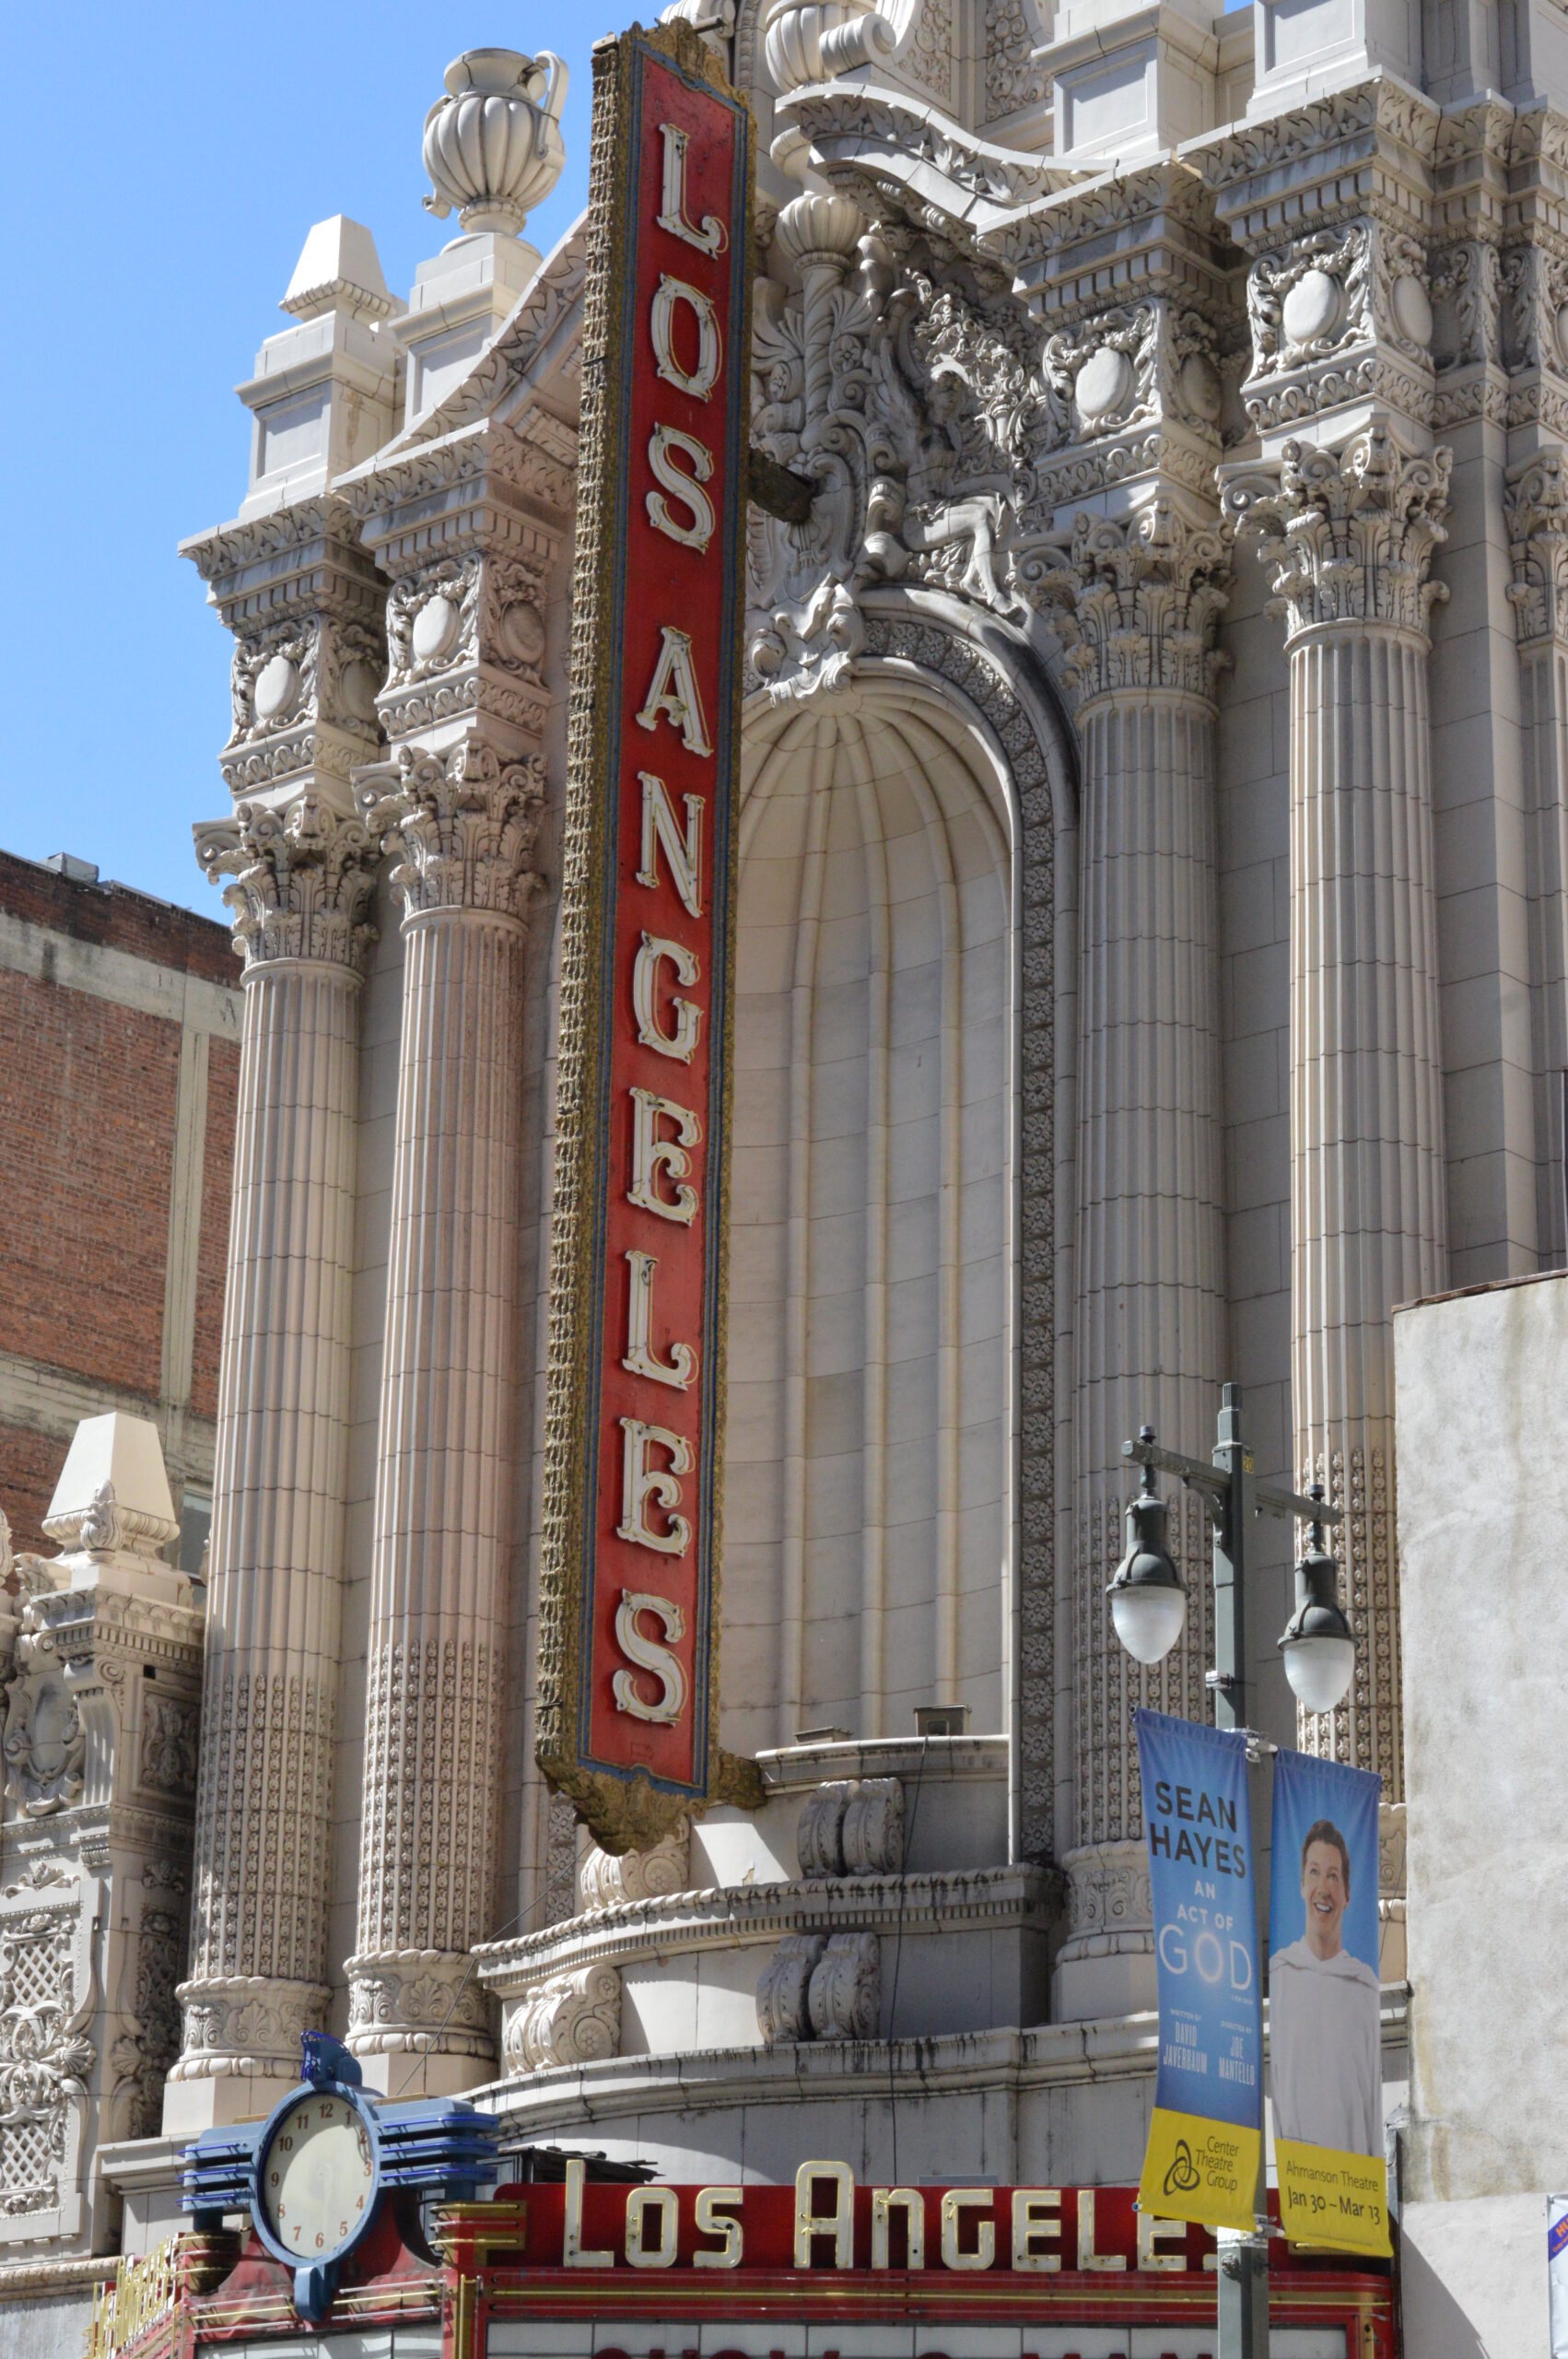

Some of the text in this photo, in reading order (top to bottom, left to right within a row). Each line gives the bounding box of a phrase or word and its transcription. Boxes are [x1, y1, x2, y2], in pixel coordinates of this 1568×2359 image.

[613, 123, 729, 1727] LOS ANGELES
[1155, 1781, 1236, 1833] SEAN
[1150, 1823, 1246, 1879] HAYES
[1194, 1880, 1216, 1900] AN
[1177, 1903, 1234, 1931] ACT OF
[1158, 1924, 1252, 1990] GOD
[1175, 2021, 1198, 2048] DAVID
[1163, 2044, 1207, 2074] JAVERBAUM
[1231, 2036, 1243, 2059] JOE
[1219, 2056, 1255, 2086] MANTELLO
[319, 2103, 333, 2118] 12
[345, 2110, 352, 2125] 1
[297, 2115, 309, 2130] 11
[277, 2136, 293, 2152] 10
[1207, 2136, 1239, 2156] Center
[364, 2162, 372, 2177] 3
[1195, 2149, 1234, 2172] Theatre
[271, 2172, 279, 2188] 9
[1206, 2170, 1238, 2195] Group
[1286, 2160, 1378, 2192] Ahmanson Theatre
[277, 2204, 286, 2219] 8
[356, 2195, 364, 2211] 4
[1288, 2185, 1307, 2210] Jan
[1310, 2194, 1326, 2213] 30
[1339, 2195, 1364, 2217] Mar
[1368, 2205, 1380, 2225] 13
[794, 2161, 1217, 2272] ANGELE
[293, 2226, 301, 2241] 7
[339, 2221, 348, 2236] 5
[315, 2233, 324, 2248] 6
